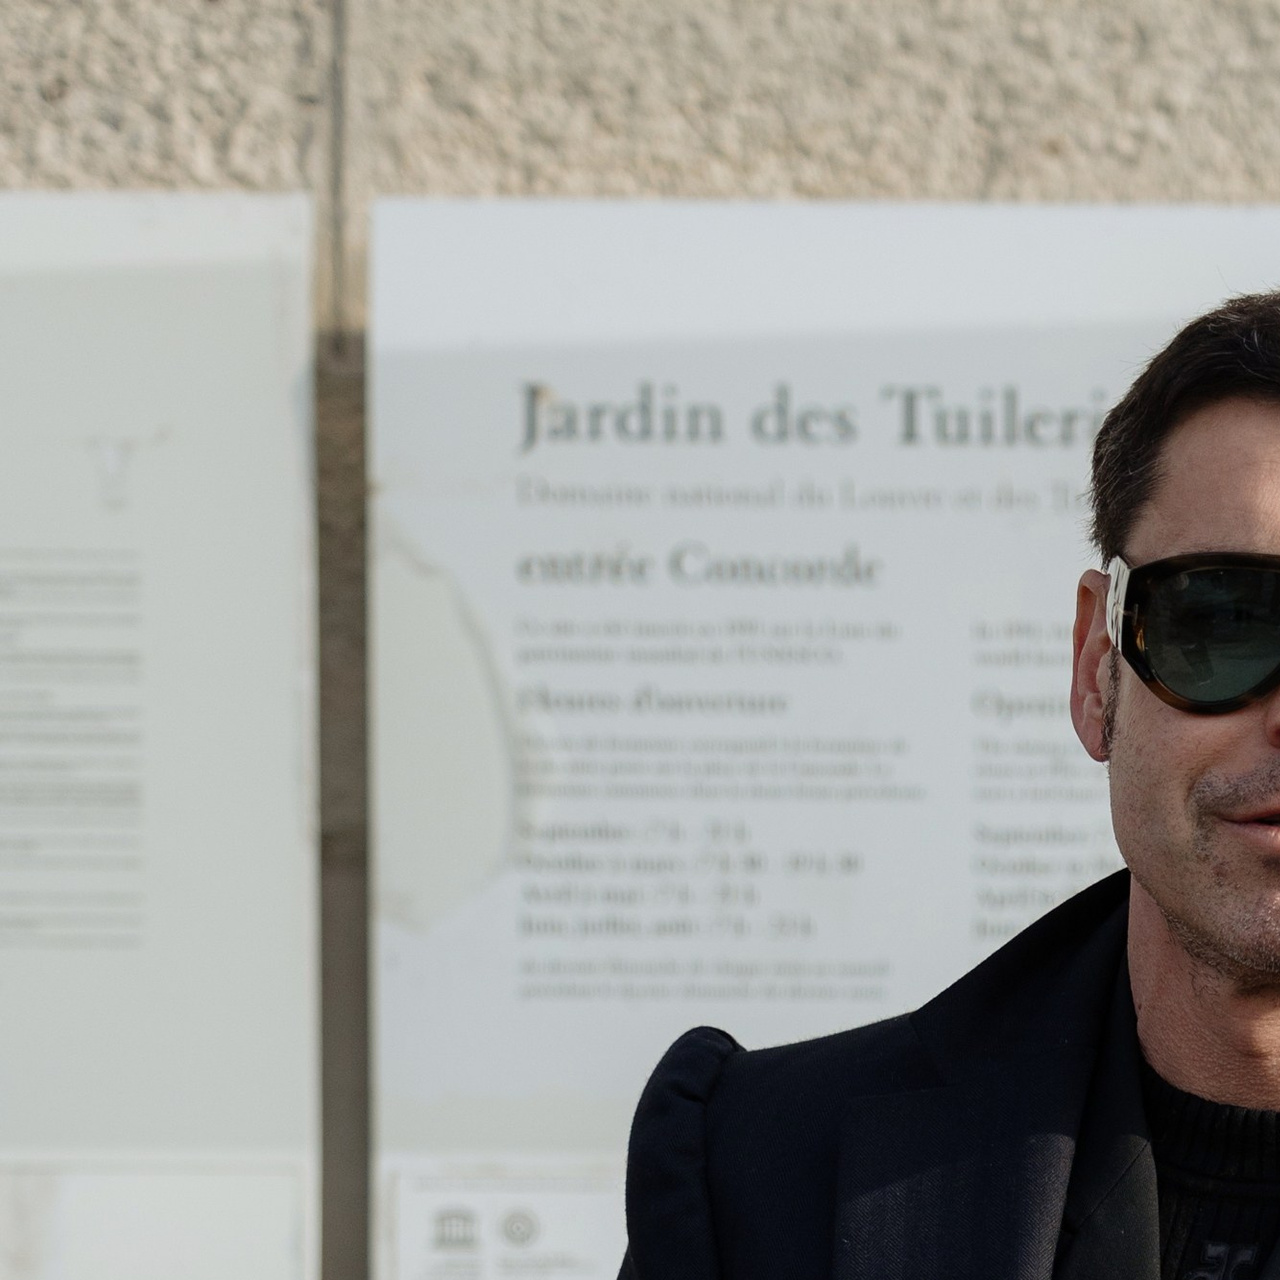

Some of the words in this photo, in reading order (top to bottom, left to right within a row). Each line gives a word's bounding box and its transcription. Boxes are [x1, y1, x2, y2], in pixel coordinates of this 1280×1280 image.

[518, 379, 725, 453] Jardin
[748, 382, 858, 447] des
[879, 384, 1107, 450] Tuileri
[667, 541, 880, 588] Concorde
